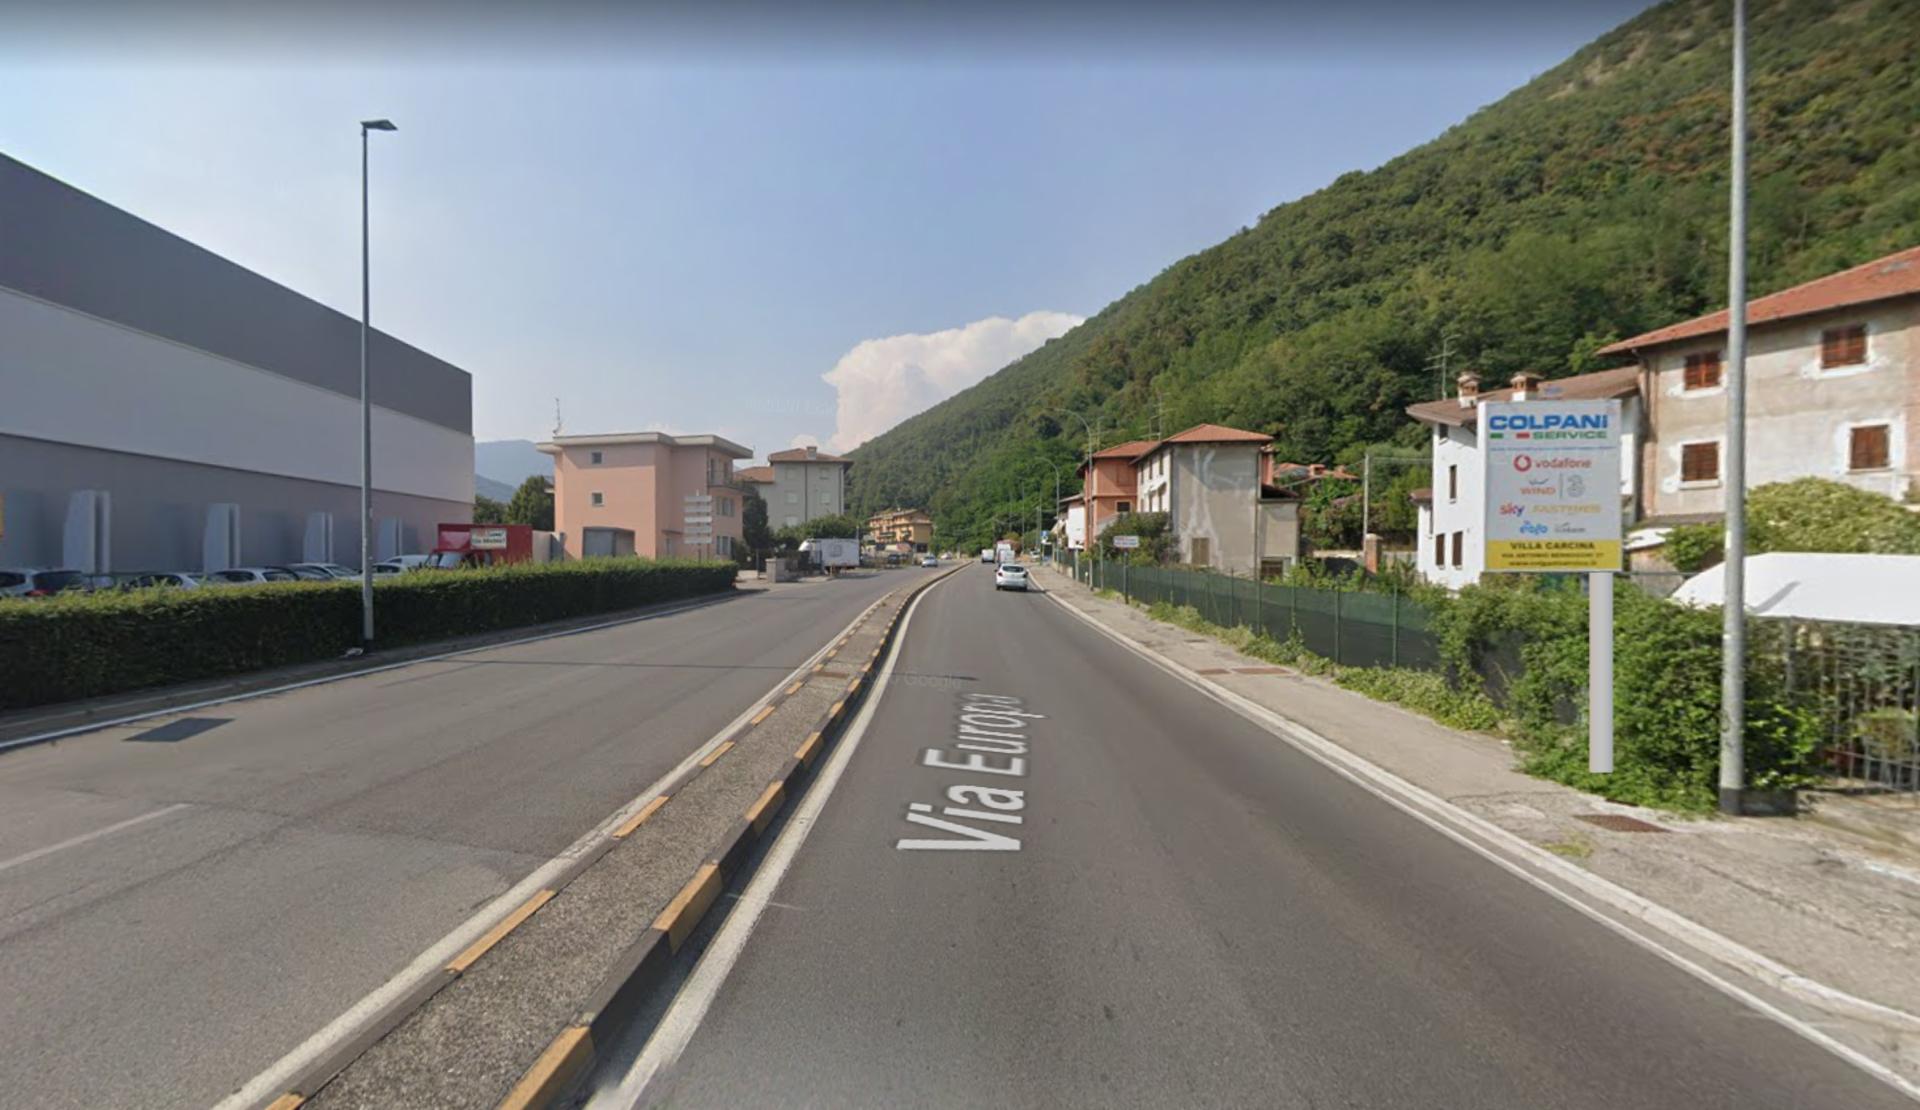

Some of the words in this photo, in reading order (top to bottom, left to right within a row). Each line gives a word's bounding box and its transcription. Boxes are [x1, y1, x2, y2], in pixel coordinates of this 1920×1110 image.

[1532, 431, 1607, 439] SERVICE
[1535, 458, 1592, 469] vodafone
[1520, 487, 1557, 495] WIND
[1499, 503, 1525, 517] sky
[1510, 542, 1542, 550] VILLA
[1545, 542, 1595, 550] CARCINA
